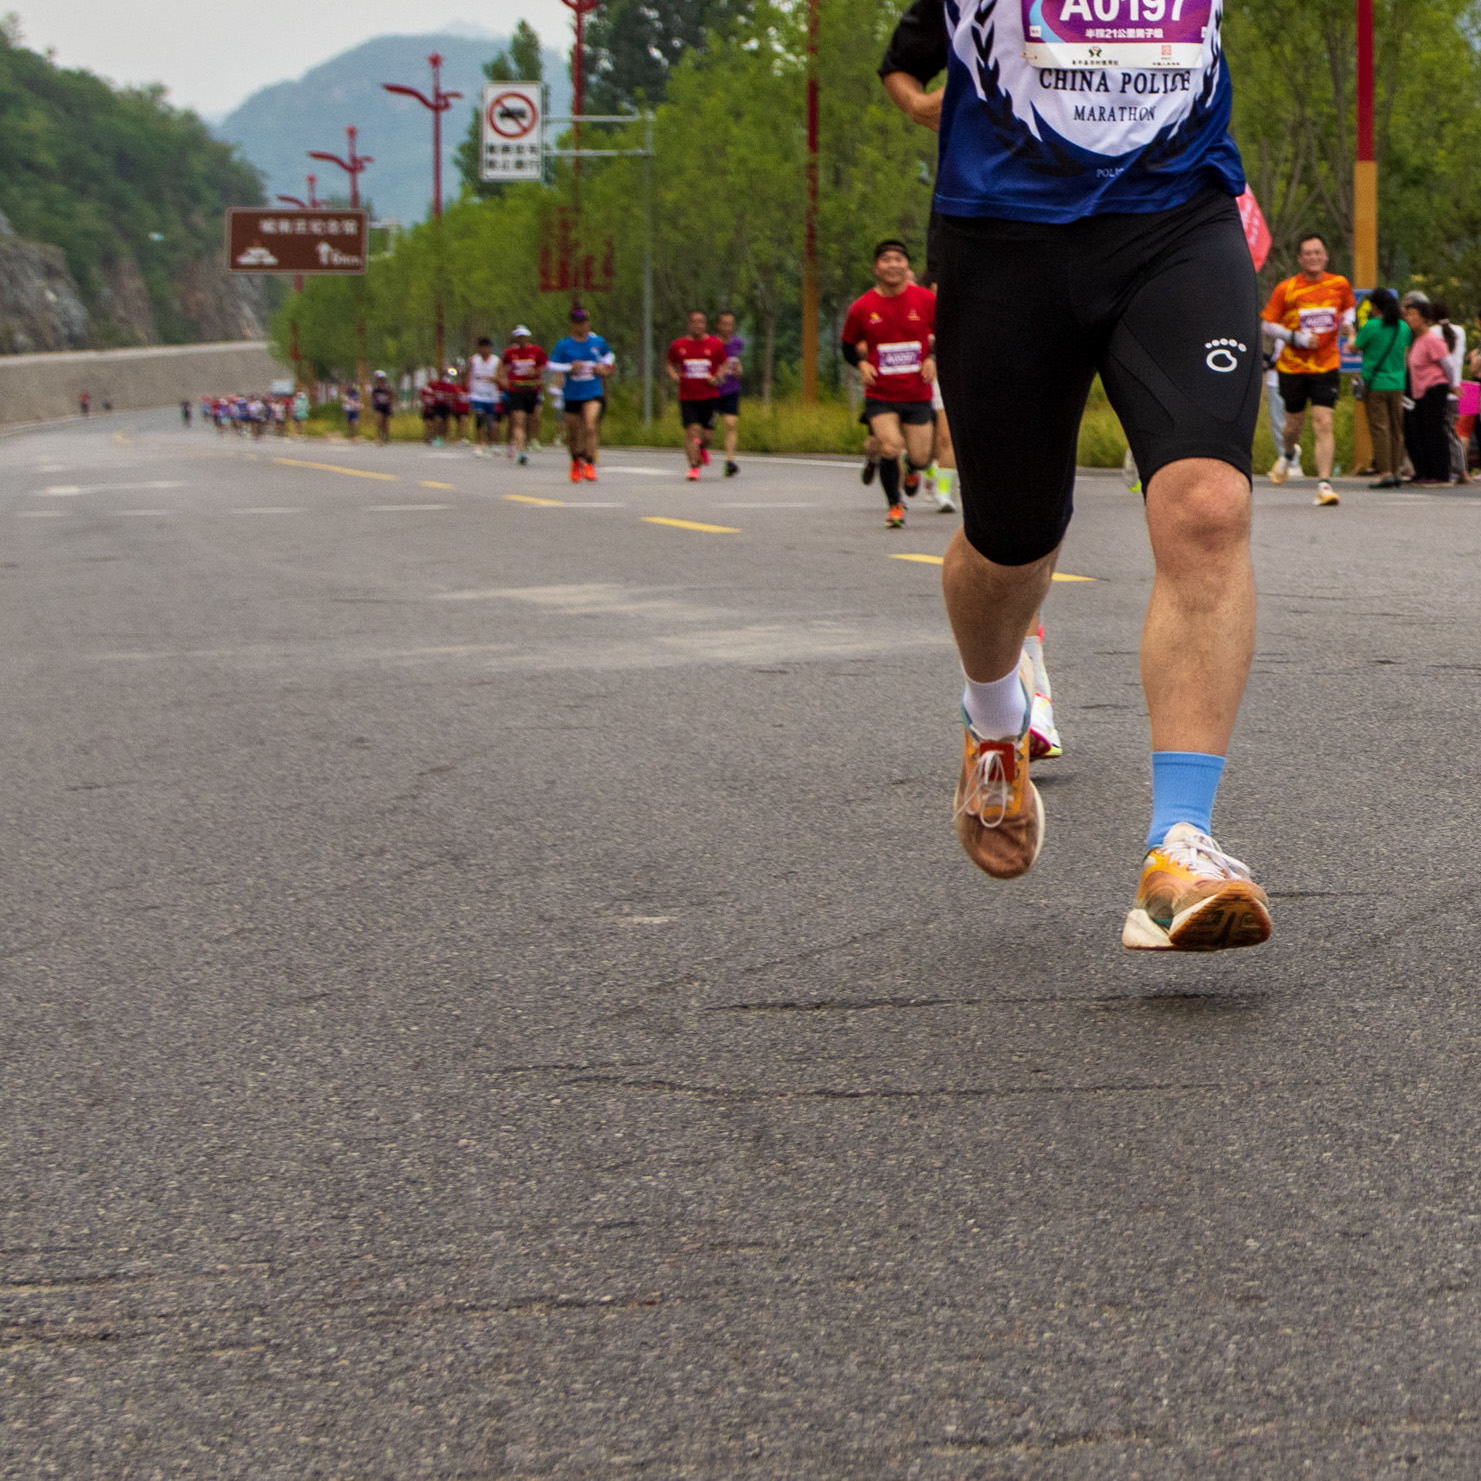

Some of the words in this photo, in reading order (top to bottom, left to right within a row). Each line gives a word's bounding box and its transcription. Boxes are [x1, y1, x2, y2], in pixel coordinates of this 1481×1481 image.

[1039, 69, 1111, 93] CHINA
[1119, 71, 1191, 95] POLICE
[1073, 104, 1158, 122] MARATHON
